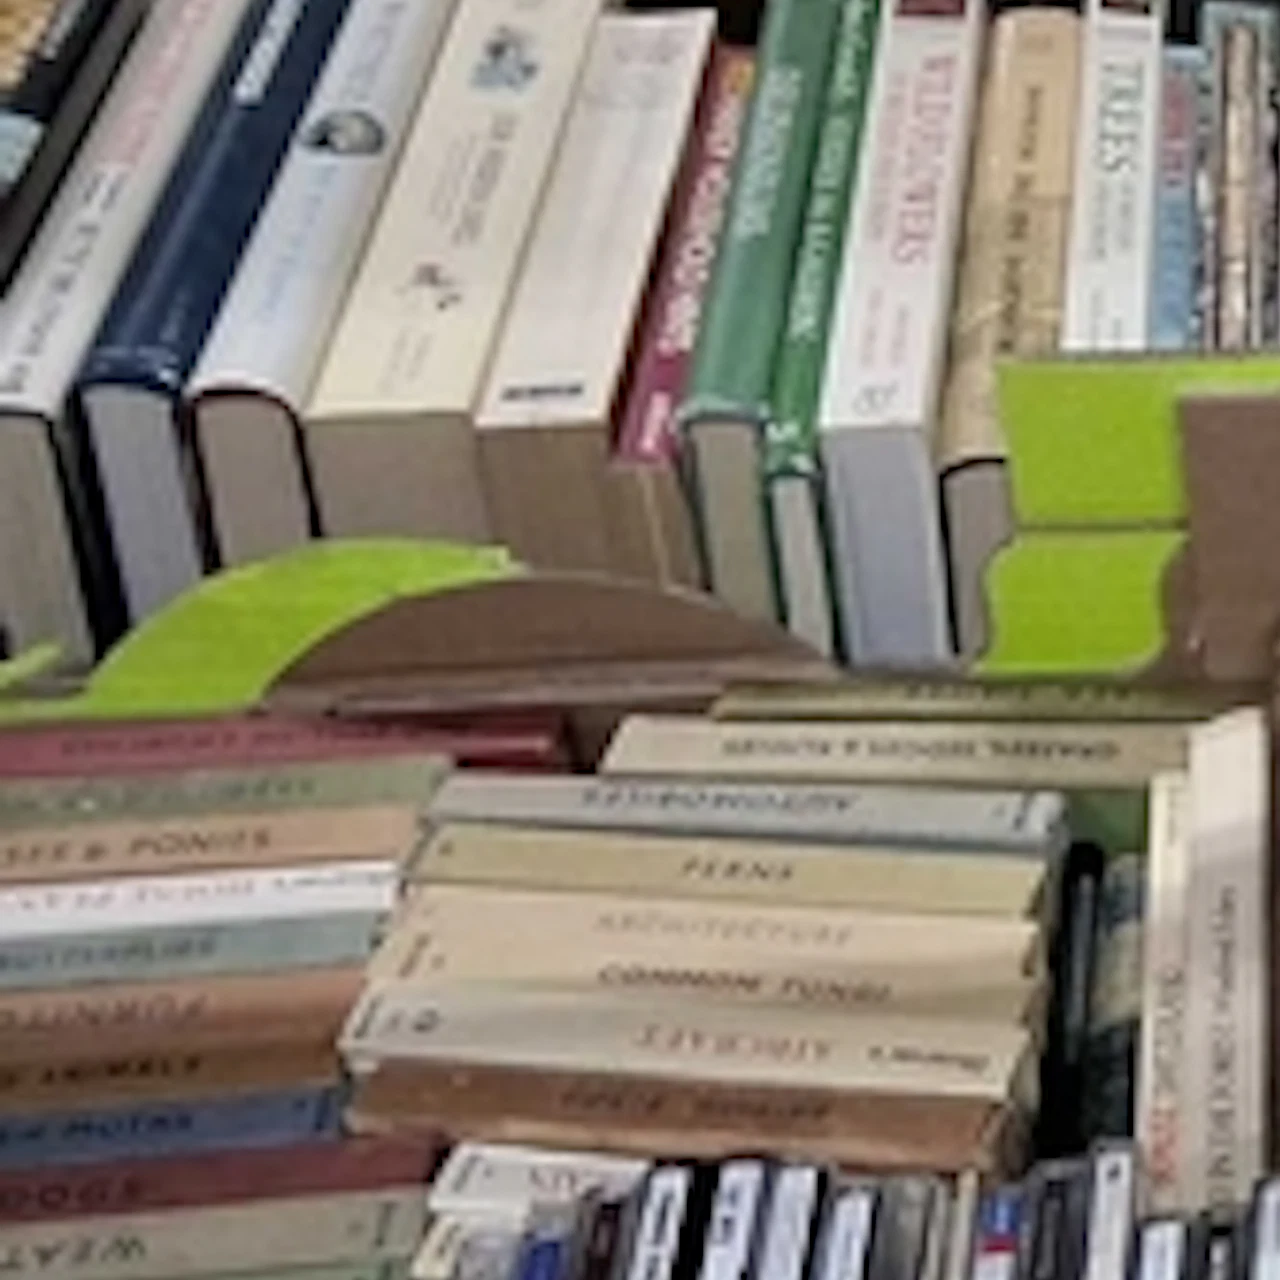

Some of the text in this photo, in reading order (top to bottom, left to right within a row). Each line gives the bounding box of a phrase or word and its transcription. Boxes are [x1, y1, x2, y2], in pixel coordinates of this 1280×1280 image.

[125, 828, 274, 860] PONIES
[678, 856, 797, 883] FERNS
[598, 962, 771, 994] COMMON
[635, 1021, 833, 1060] AIRCRAFT
